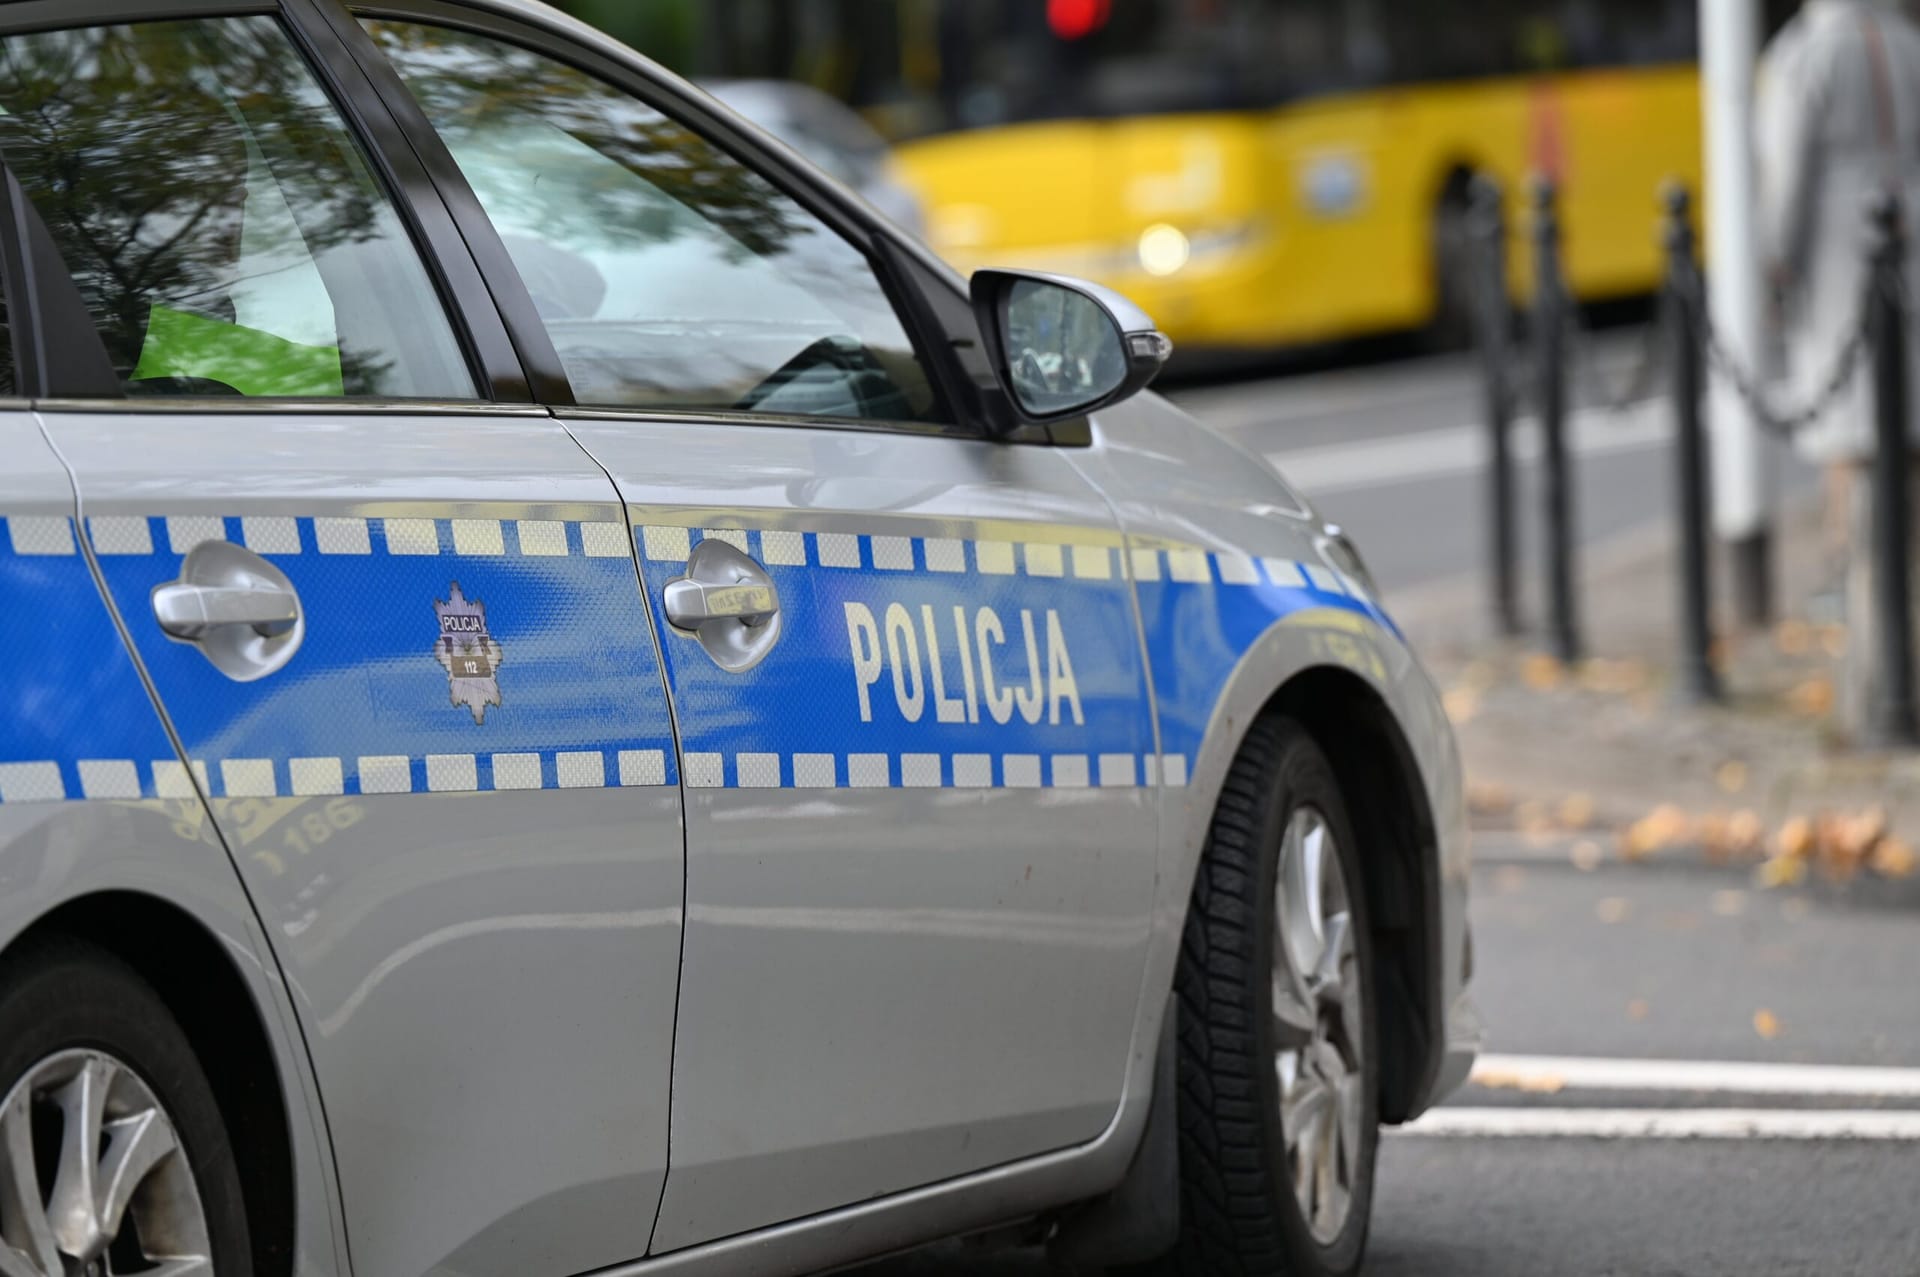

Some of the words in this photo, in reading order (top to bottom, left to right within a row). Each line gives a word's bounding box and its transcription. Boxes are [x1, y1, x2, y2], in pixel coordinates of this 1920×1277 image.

[443, 616, 481, 631] POLICJA
[464, 660, 478, 674] 112
[844, 601, 1085, 726] POLICJA
